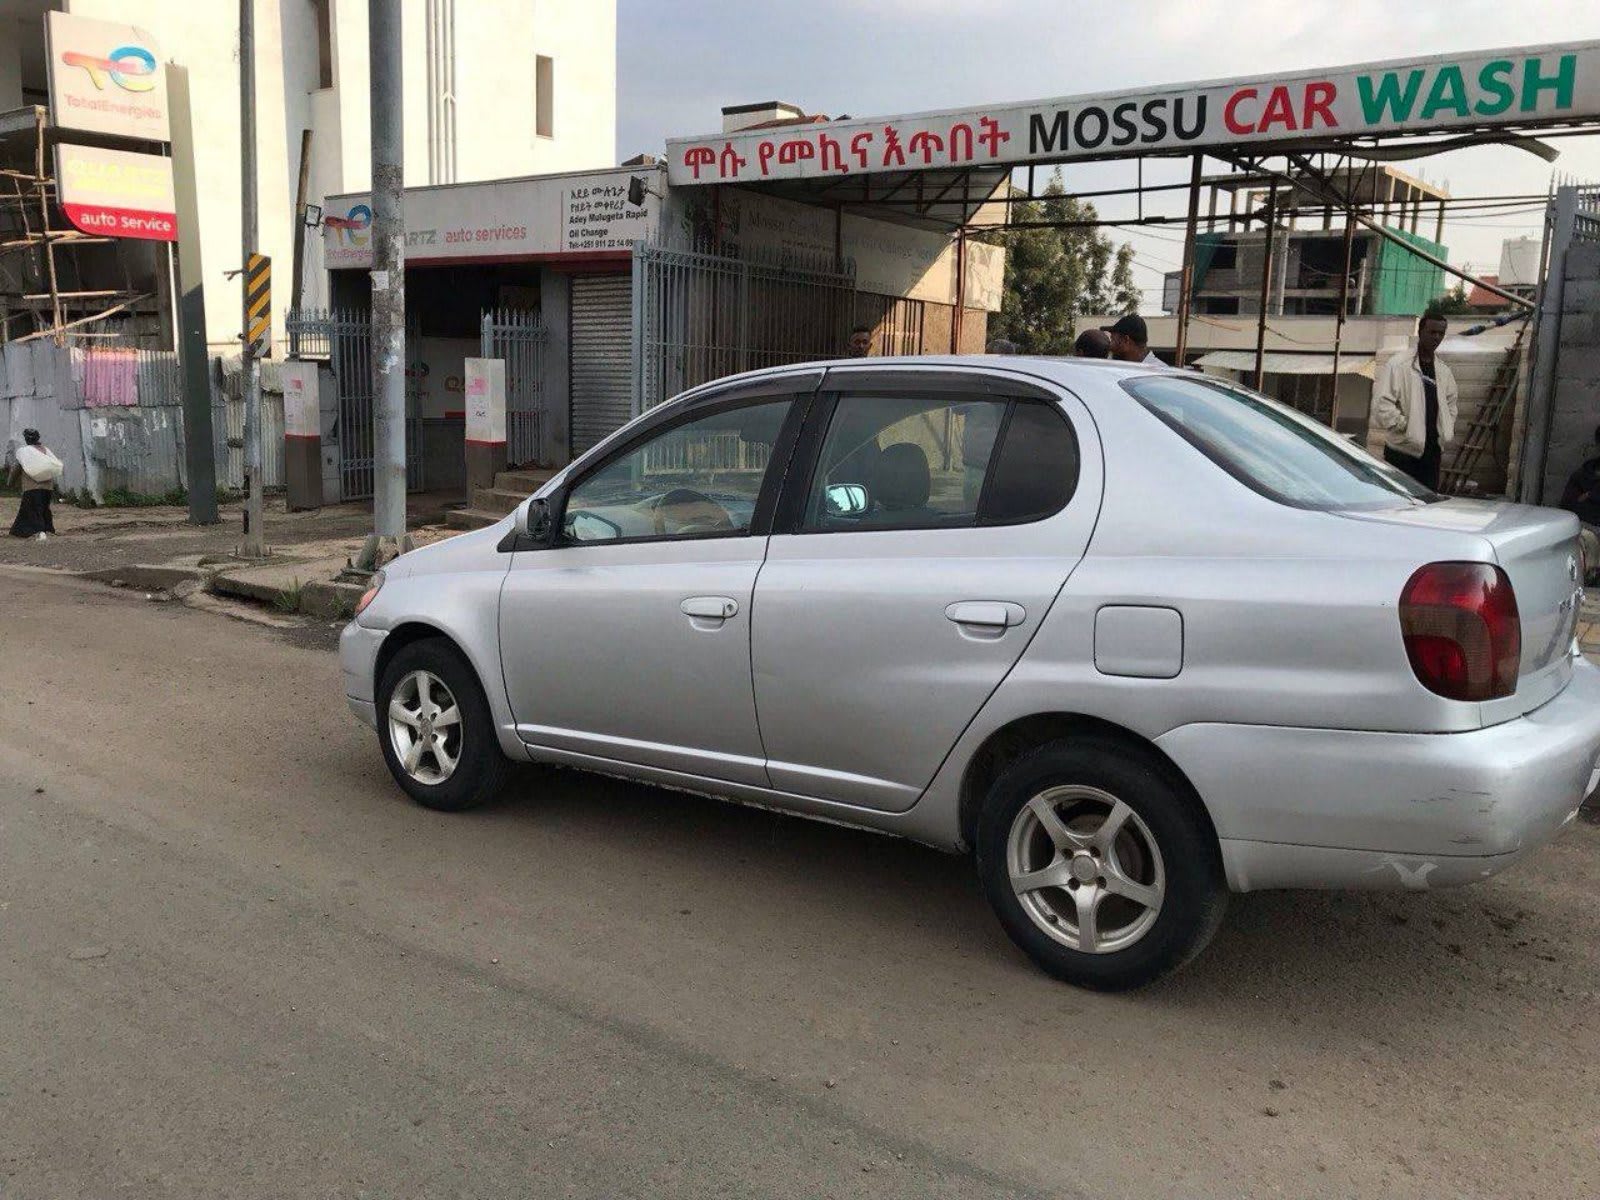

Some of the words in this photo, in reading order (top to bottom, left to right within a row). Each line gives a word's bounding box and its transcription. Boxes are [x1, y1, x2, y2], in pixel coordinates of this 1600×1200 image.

[1029, 95, 1207, 155] MOSSU
[1223, 82, 1338, 134] CAR
[1357, 55, 1576, 124] WASH
[758, 131, 873, 175] የመኪና
[883, 115, 1011, 167] እጥበት
[80, 211, 117, 226] auto
[120, 214, 172, 232] service
[588, 212, 624, 222] Mulugeta
[625, 209, 648, 220] Rapid
[445, 228, 473, 244] auto
[475, 224, 527, 242] services
[581, 229, 608, 238] Change
